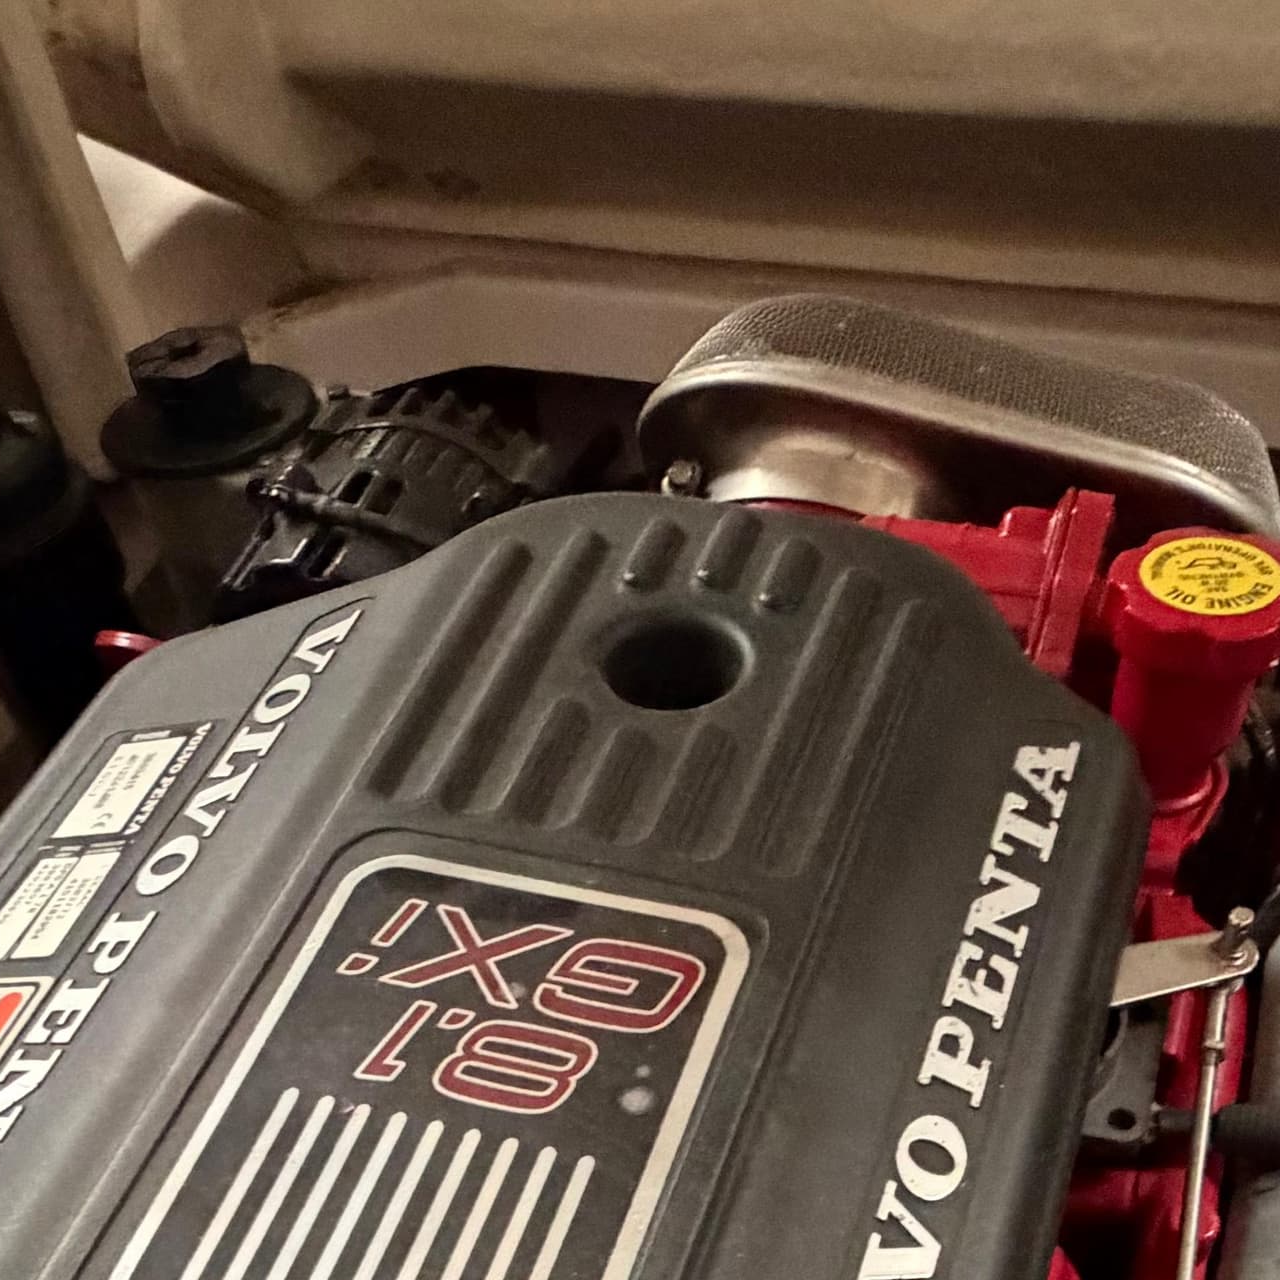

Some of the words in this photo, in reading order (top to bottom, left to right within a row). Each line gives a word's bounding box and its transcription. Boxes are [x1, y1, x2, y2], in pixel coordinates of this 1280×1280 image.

[1168, 586, 1197, 606] OIL
[136, 608, 363, 896] VOLVO
[163, 721, 216, 775] VOLVO
[119, 775, 177, 835] PENTA
[917, 740, 1081, 1108] PENTA
[353, 1000, 598, 1114] 8.1
